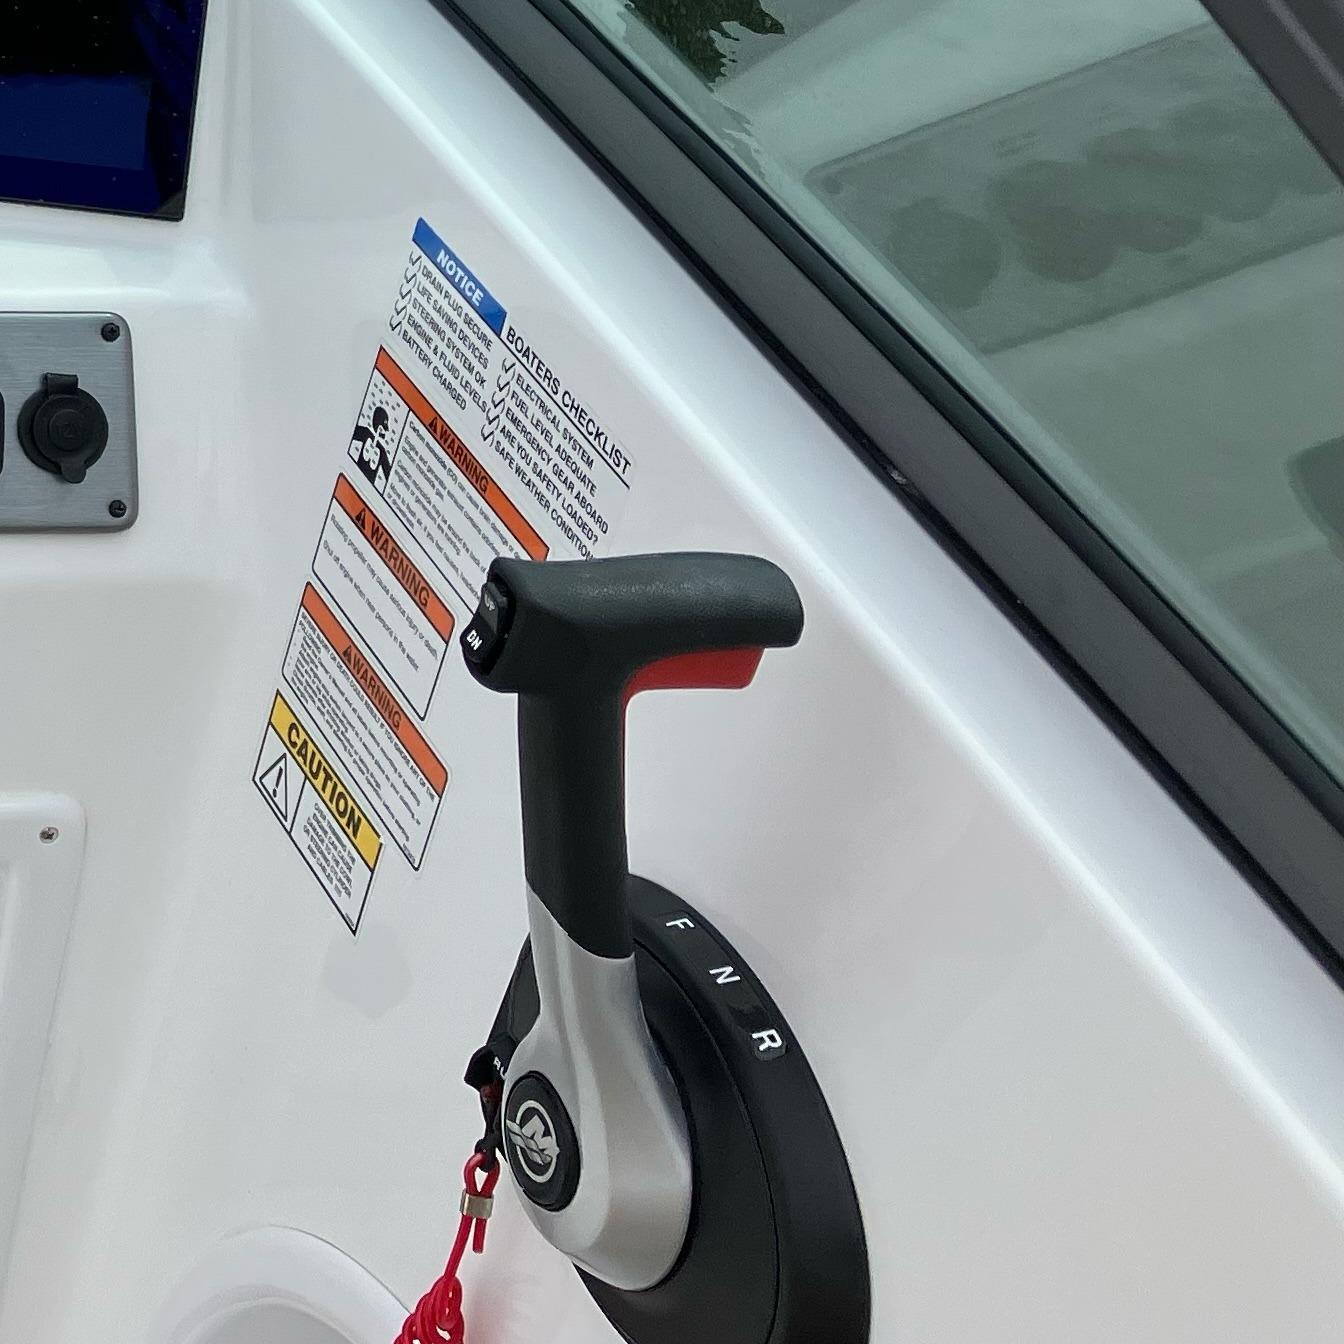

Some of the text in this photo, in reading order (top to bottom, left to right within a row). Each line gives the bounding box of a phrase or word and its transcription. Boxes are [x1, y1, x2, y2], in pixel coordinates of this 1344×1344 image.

[421, 264, 492, 352] DRAIN PLUG SECURE
[436, 245, 483, 309] NOTICE
[406, 313, 487, 413] ENGINE & FLUID LEVELS
[411, 297, 486, 390] STEERING SYSTEM OK
[416, 280, 488, 370] LIFE SAVING DEVICES
[401, 329, 467, 411] BATTERY CHARGED
[505, 325, 631, 478] BOATERS CHECKLIST
[438, 424, 489, 494] WARNING
[510, 390, 597, 497] FUEL LEVEL ADEQUATE
[515, 373, 594, 470] ELECTRICAL SYSTEM
[494, 439, 516, 470] SAFE
[514, 462, 550, 512] WEATHER
[499, 422, 598, 547] ARE YOU SAFETY LOADED?
[505, 406, 608, 535] EMERGENCY GEAR ABOARD
[368, 519, 430, 609] WARNING
[466, 630, 483, 651] DN
[351, 652, 402, 731] WARNING
[286, 717, 361, 840] CAUTION
[665, 917, 695, 930] F
[709, 966, 741, 985] N
[752, 1028, 783, 1052] R
